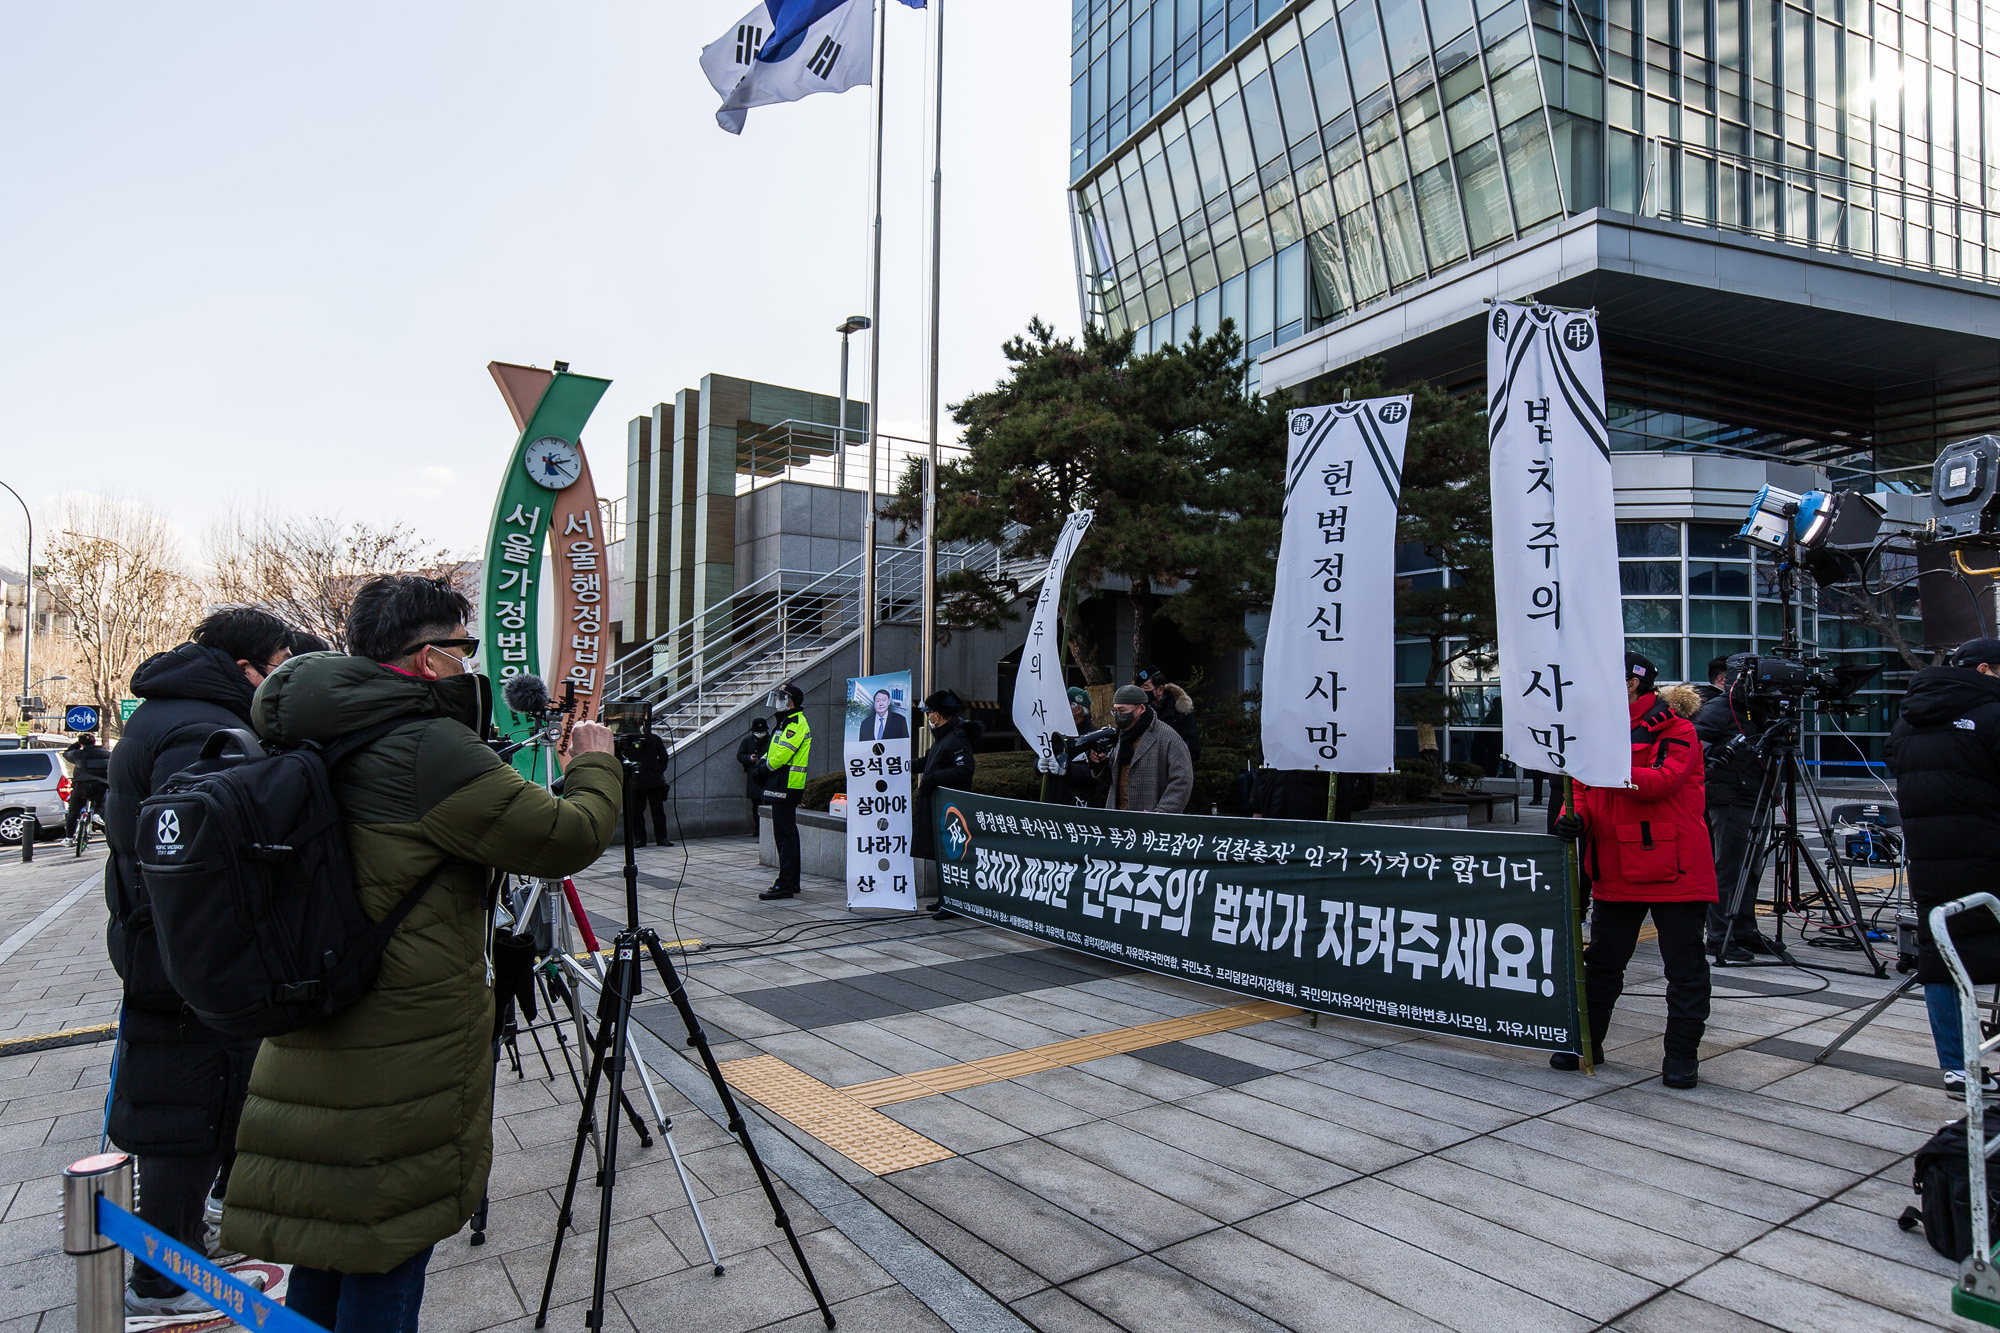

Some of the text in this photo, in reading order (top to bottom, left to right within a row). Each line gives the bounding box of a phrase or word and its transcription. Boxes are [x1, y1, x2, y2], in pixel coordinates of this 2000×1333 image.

[1567, 321, 1589, 348] 弔
[1382, 404, 1403, 422] 弔
[564, 510, 600, 695] 서울행정법원
[1304, 460, 1354, 760] 헌법정신 사망
[1522, 664, 1577, 768] 사망
[856, 795, 907, 816] 살아야
[856, 835, 907, 854] 나라가
[942, 862, 970, 888] 법무부
[975, 811, 1020, 834] 행정법원
[1020, 817, 1062, 840] 판사님!
[1063, 822, 1106, 846] 법무부
[1108, 827, 1136, 850] 폭정
[1142, 830, 1204, 859] 바로잡아
[1360, 850, 1442, 880] 지켜야
[1450, 855, 1550, 892] 합니다.
[975, 848, 1020, 896] 정치가
[1020, 857, 1078, 908] 파괴한
[1212, 883, 1308, 958] 법치가
[1317, 900, 1554, 998] 지켜주세요!
[1046, 925, 1066, 940] 자유연대,
[1066, 931, 1082, 944] GZSS,
[1084, 935, 1124, 956] 공익지킴이센터,
[1126, 946, 1179, 970] 자유민주국민연합,
[1181, 959, 1213, 978] 국민노조,
[1216, 967, 1297, 998] 프리덤칼리지장학회,
[1301, 986, 1492, 1034] 국민의자유와인권을위한변호사모임,
[1496, 1020, 1568, 1043] 자유시민당
[164, 1246, 244, 1314] 서울서초경찰서장
